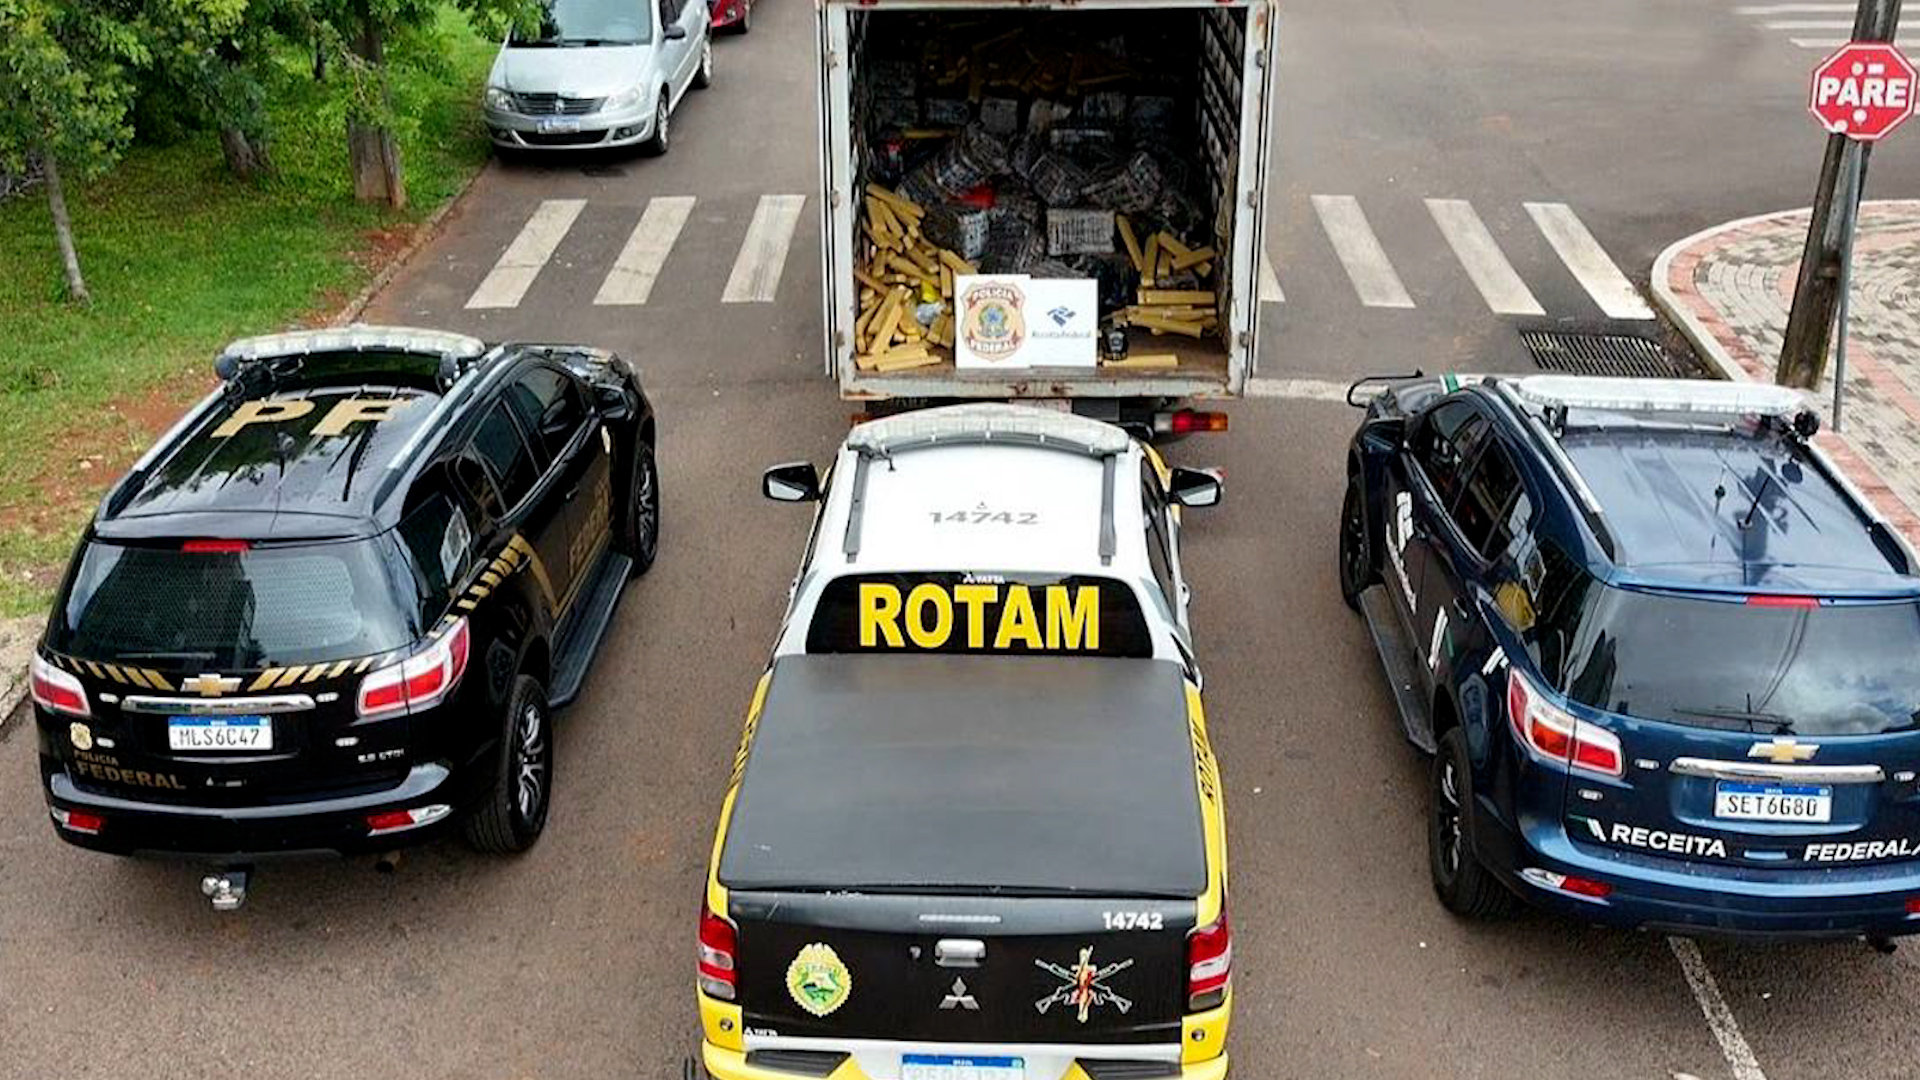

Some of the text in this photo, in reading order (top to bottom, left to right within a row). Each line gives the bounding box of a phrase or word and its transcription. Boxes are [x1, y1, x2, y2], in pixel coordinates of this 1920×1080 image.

[1819, 77, 1909, 107] PARE
[211, 398, 412, 438] PF
[929, 510, 1040, 525] 14742
[859, 582, 1100, 650] ROTAM
[75, 760, 187, 790] FEDERAL
[1727, 794, 1819, 817] SET6G80
[1611, 823, 1911, 862] RECEITA FEDERAL
[1102, 912, 1164, 930] 14742
